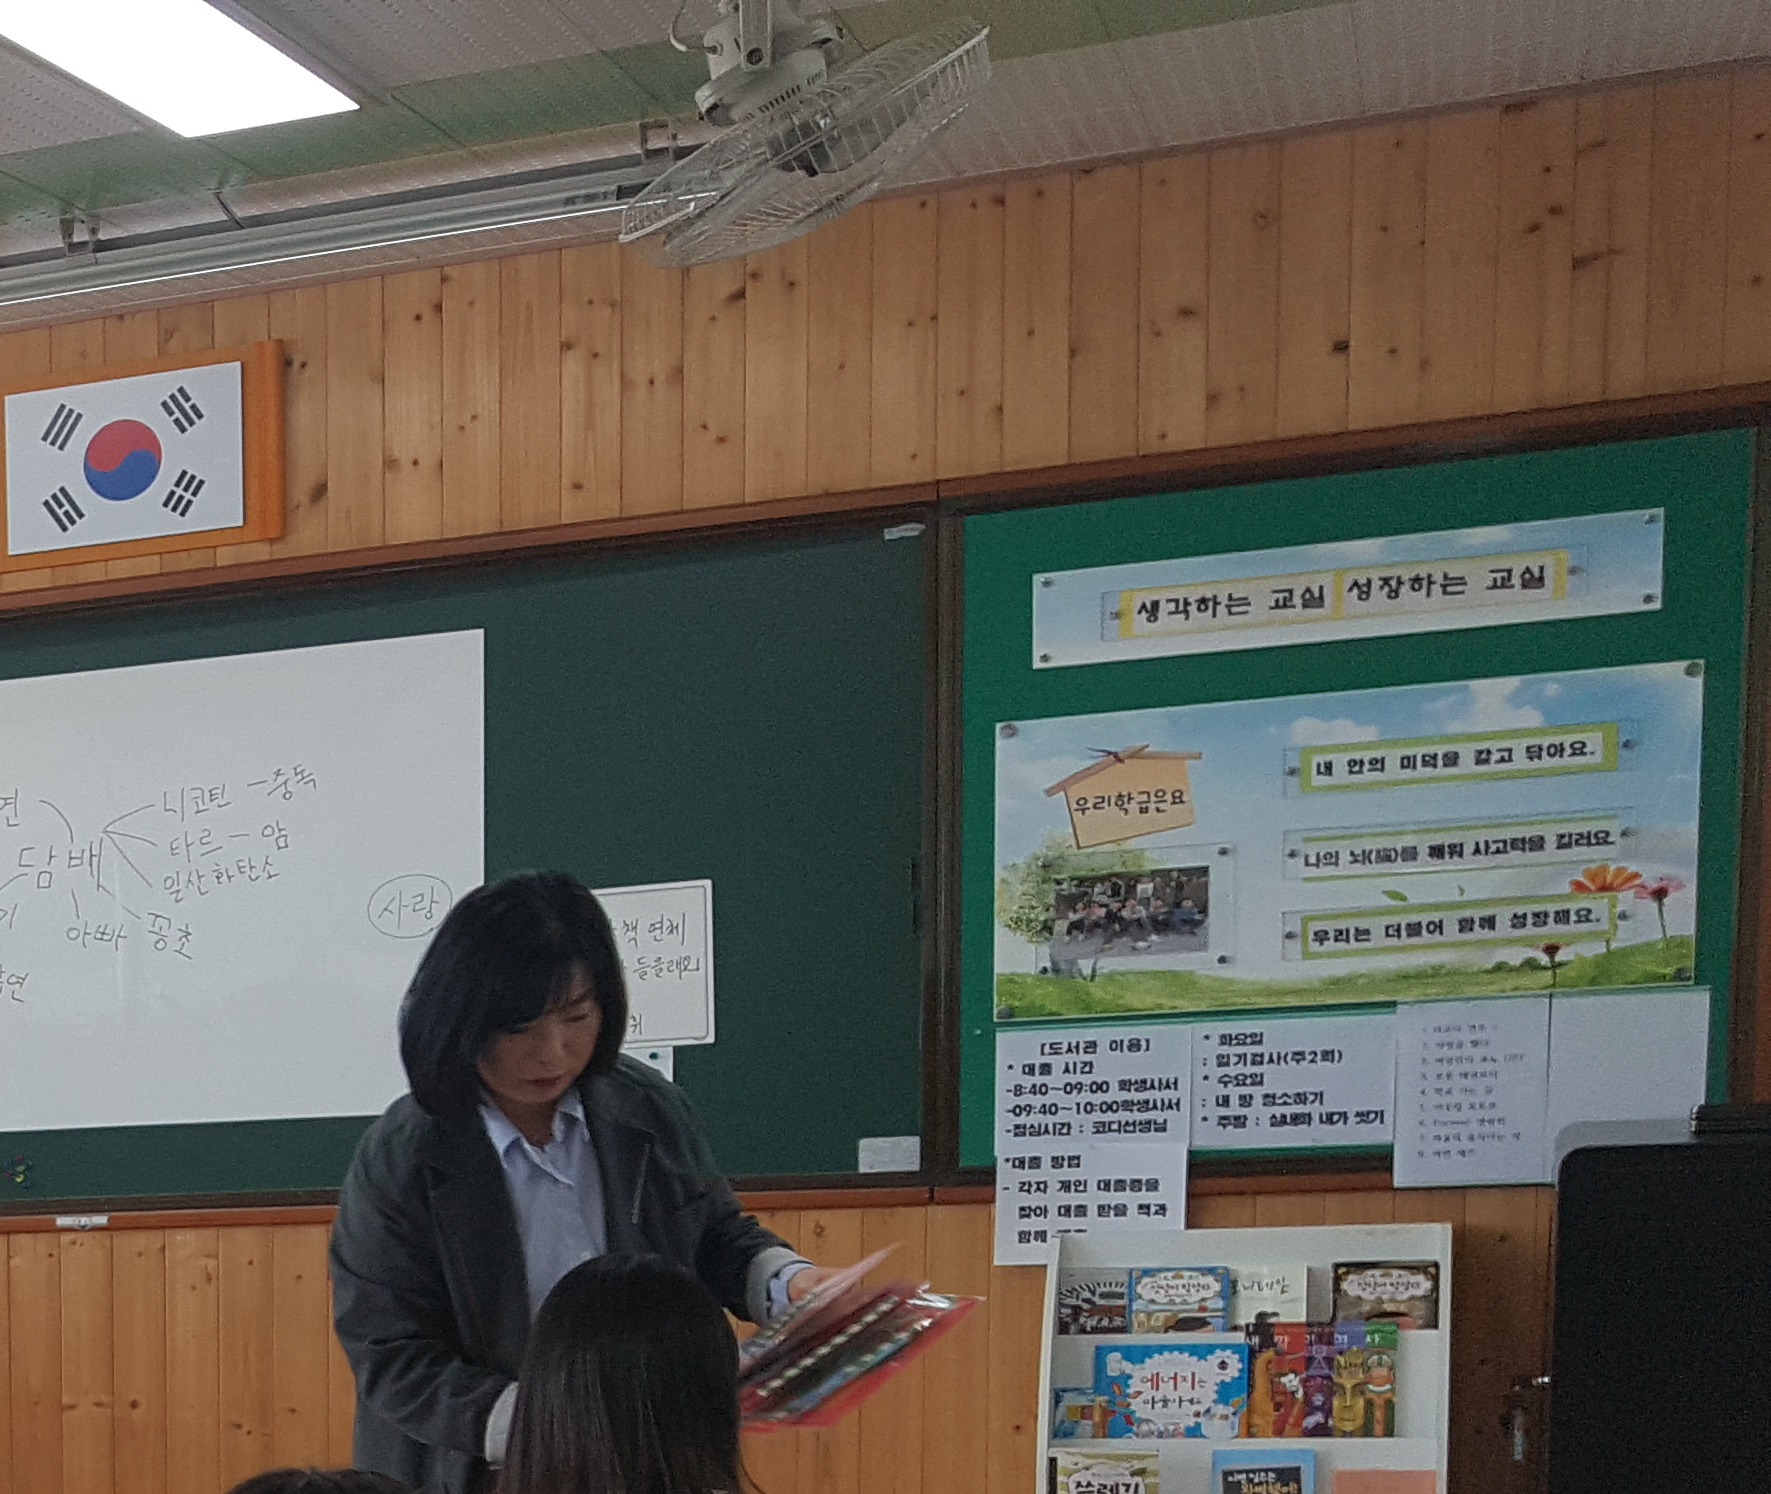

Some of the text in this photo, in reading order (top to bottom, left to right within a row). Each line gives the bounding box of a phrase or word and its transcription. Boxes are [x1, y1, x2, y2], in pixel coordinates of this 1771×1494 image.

[1137, 564, 1548, 624] 생각하는 교실 성장하는 교실
[1315, 739, 1596, 777] 내 안의 미덕을 갈고 닦아요.
[267, 764, 318, 800] 중독
[163, 784, 232, 823] 니코틴
[1074, 788, 1186, 816] 우리학급은요
[170, 829, 224, 863] 타르
[261, 820, 289, 850] 암
[19, 837, 103, 891] 담배
[1304, 850, 1339, 868] 나의
[164, 855, 280, 903] 일산화탄소
[377, 885, 441, 930] 사랑
[66, 920, 128, 952] 아빠
[147, 912, 194, 960] 꽁초
[623, 913, 686, 949] 책 연체
[1311, 906, 1601, 946] 우리는 더불어 함께 성장해요.
[1040, 1038, 1151, 1056] [도서관 이용]
[1217, 1031, 1264, 1047] 화요일
[1022, 1060, 1094, 1077] 대출 시간
[1217, 1072, 1265, 1088] 수요일
[1117, 1077, 1179, 1093] 학생사서
[1262, 1091, 1325, 1107] 청소하기
[1091, 1118, 1168, 1135] 코디선생님
[1051, 1154, 1082, 1169] 방법
[1018, 1180, 1049, 1195] 각자
[1056, 1179, 1088, 1194] 개인
